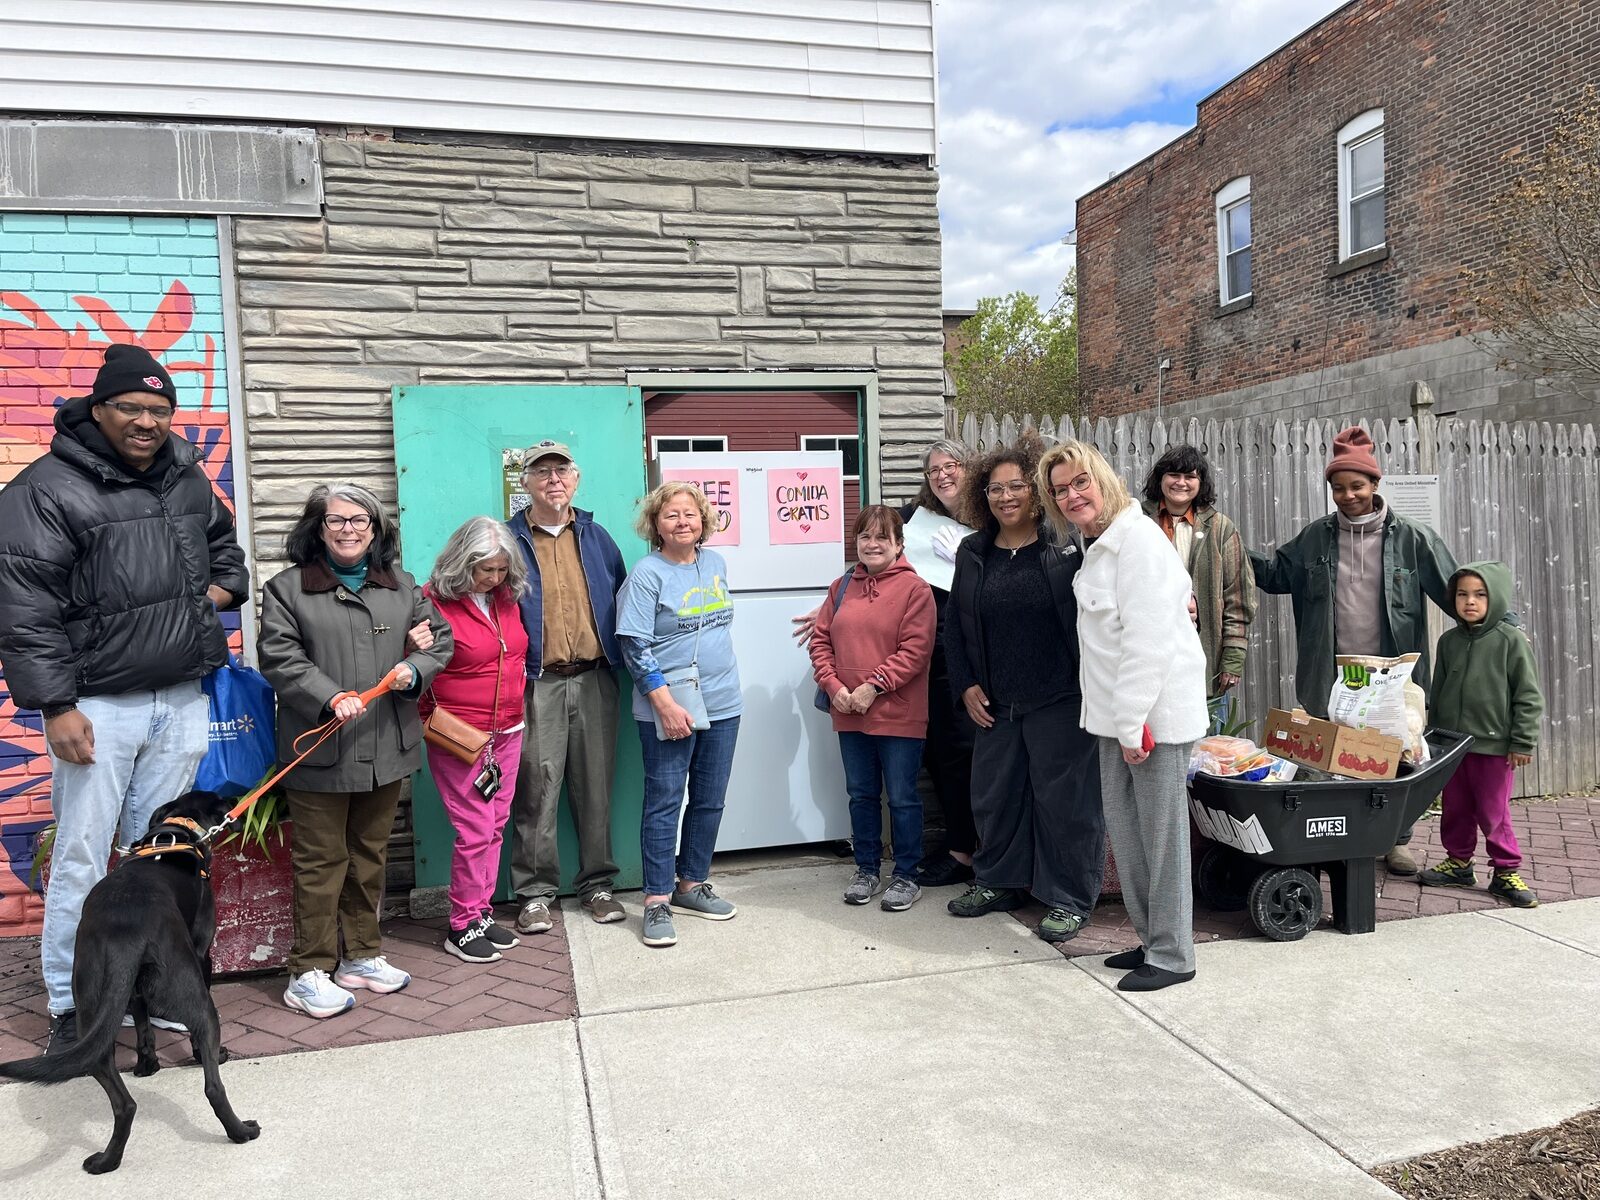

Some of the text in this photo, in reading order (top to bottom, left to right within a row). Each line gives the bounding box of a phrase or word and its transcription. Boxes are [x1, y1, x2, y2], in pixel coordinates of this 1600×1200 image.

[776, 485, 829, 504] COMIDA
[777, 504, 830, 522] GRATIS
[209, 719, 236, 731] mart
[1309, 820, 1342, 833] AMES
